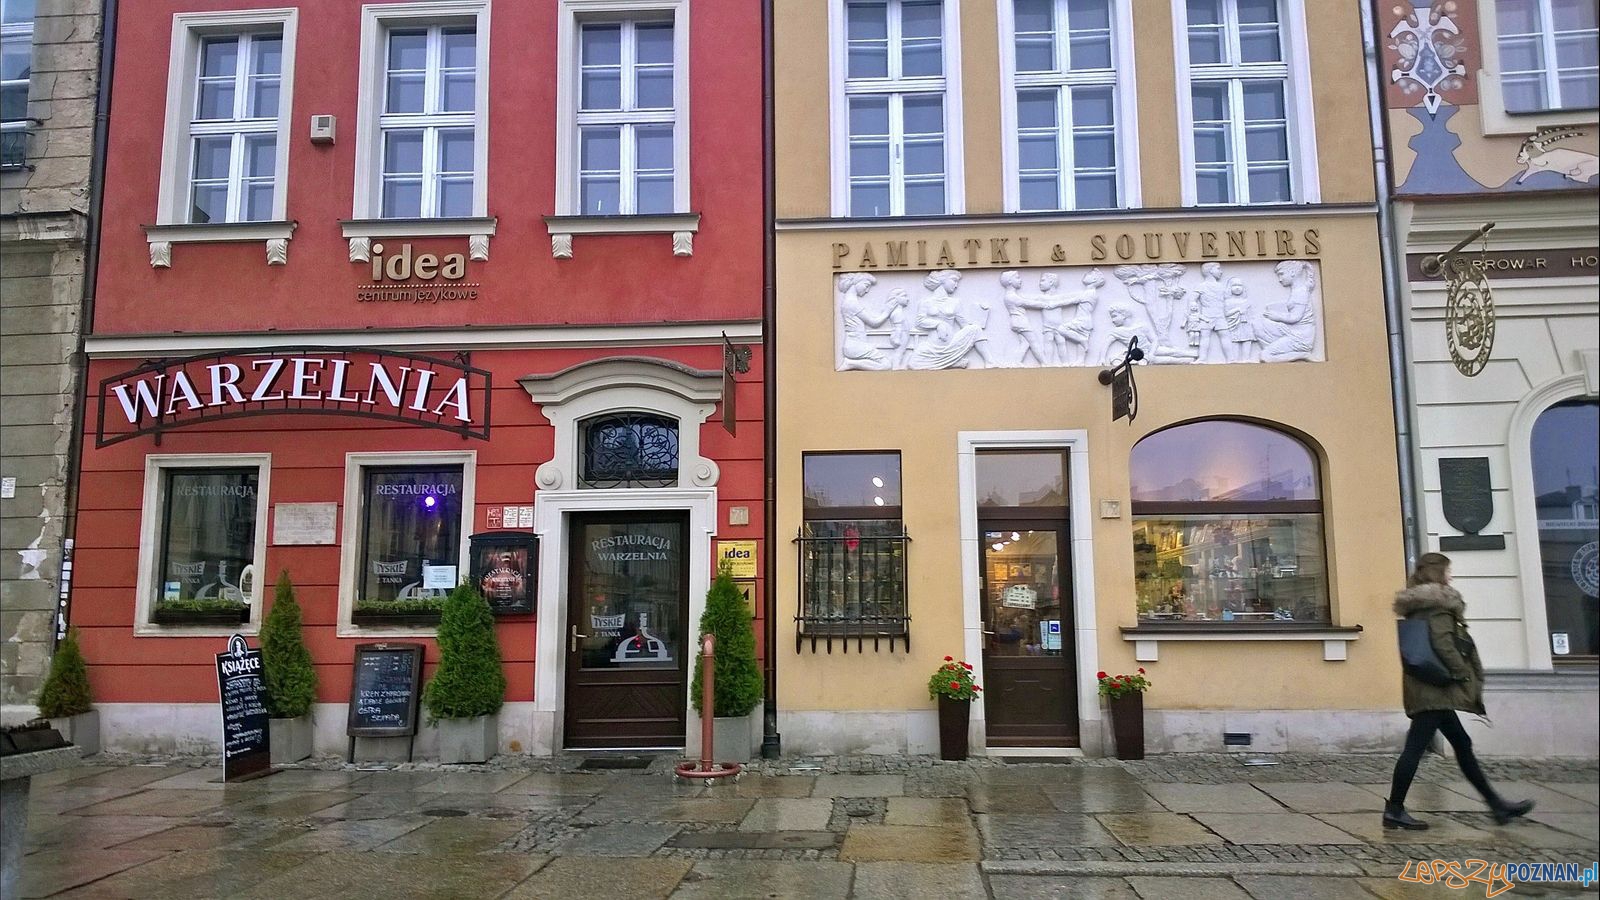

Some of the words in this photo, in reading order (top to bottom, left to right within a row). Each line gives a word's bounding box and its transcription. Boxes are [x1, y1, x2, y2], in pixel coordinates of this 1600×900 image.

[832, 236, 1030, 270] PAMIĄTKI
[1051, 243, 1068, 263] &
[1091, 227, 1322, 262] SOUVENIRS
[372, 243, 465, 281] idea
[356, 289, 411, 302] centrum
[413, 288, 478, 303] językowe
[111, 357, 472, 424] WARZELNIA
[176, 485, 254, 498] RESTAURACJA
[376, 484, 456, 497] RESTAURACJA
[591, 534, 671, 551] RESTAURACJA
[597, 552, 668, 561] WARZELNIA
[724, 547, 750, 559] idea
[376, 563, 405, 573] TYSKIE
[594, 616, 622, 627] TYSKIE
[221, 656, 261, 677] KSIĄŻĘCE
